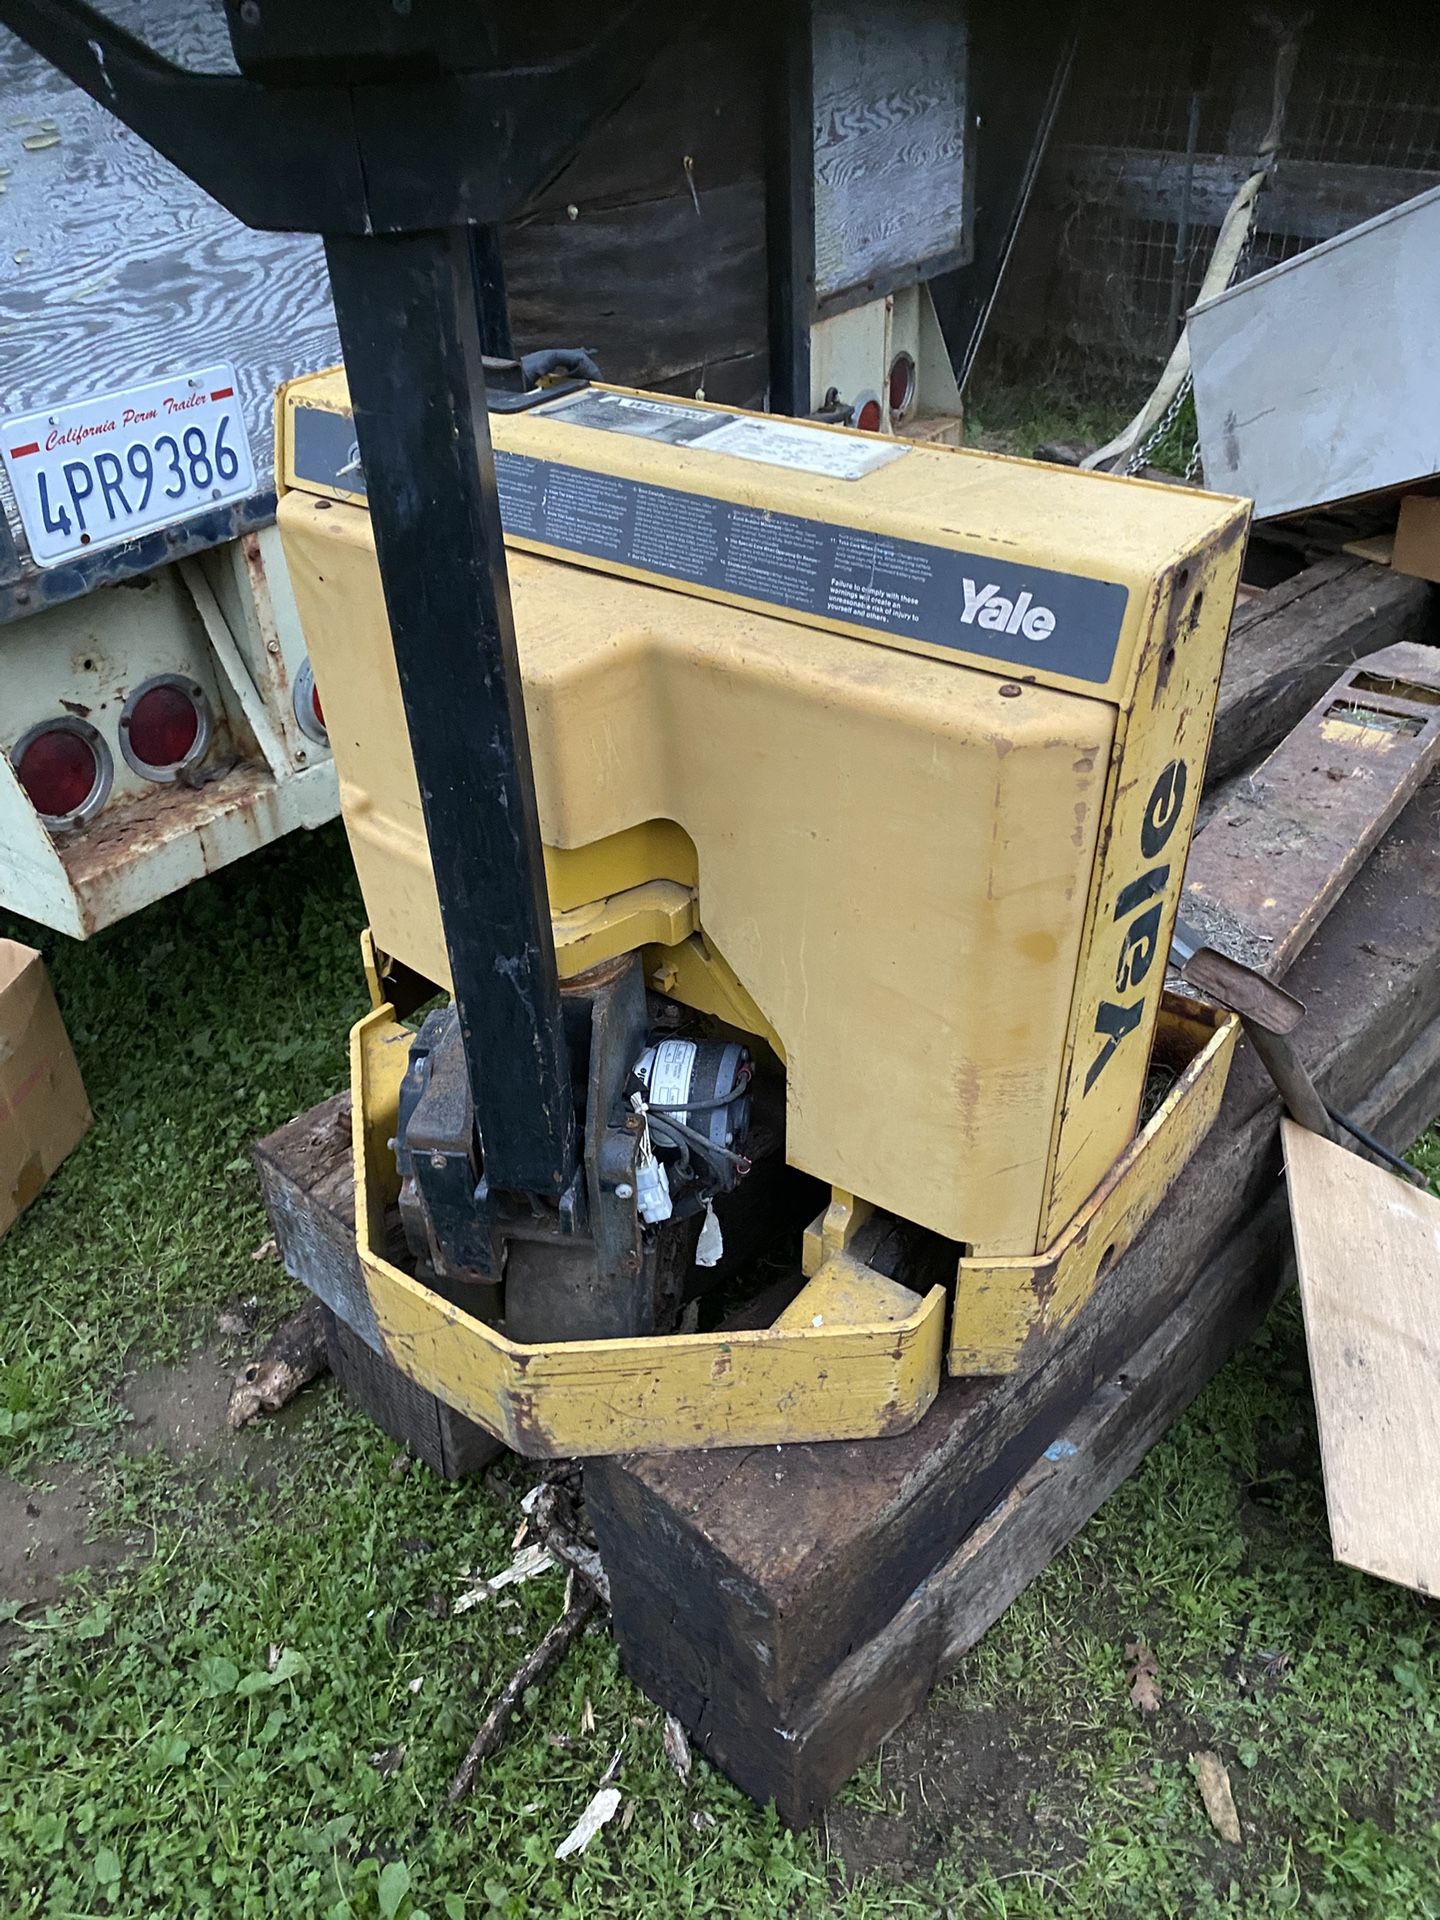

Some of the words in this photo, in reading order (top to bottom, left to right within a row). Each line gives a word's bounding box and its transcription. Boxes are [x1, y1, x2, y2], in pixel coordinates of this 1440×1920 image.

[44, 419, 117, 452] California
[122, 408, 158, 429] Perm
[163, 394, 207, 415] Trailer
[37, 415, 240, 536] 4PR9386
[827, 601, 852, 615] yourself
[853, 607, 865, 618] and
[866, 610, 889, 624] others.
[830, 585, 857, 600] warnings
[859, 592, 870, 603] will
[871, 595, 891, 608] create
[892, 600, 901, 611] an
[831, 577, 855, 591] Failure
[854, 582, 860, 592] to
[886, 590, 899, 601] with
[900, 594, 918, 606] these
[871, 603, 883, 614] risk
[884, 607, 892, 616] of
[892, 609, 911, 621] injury
[912, 613, 919, 623] to
[960, 577, 1057, 641] Yale
[1082, 758, 1188, 1100] Yale
